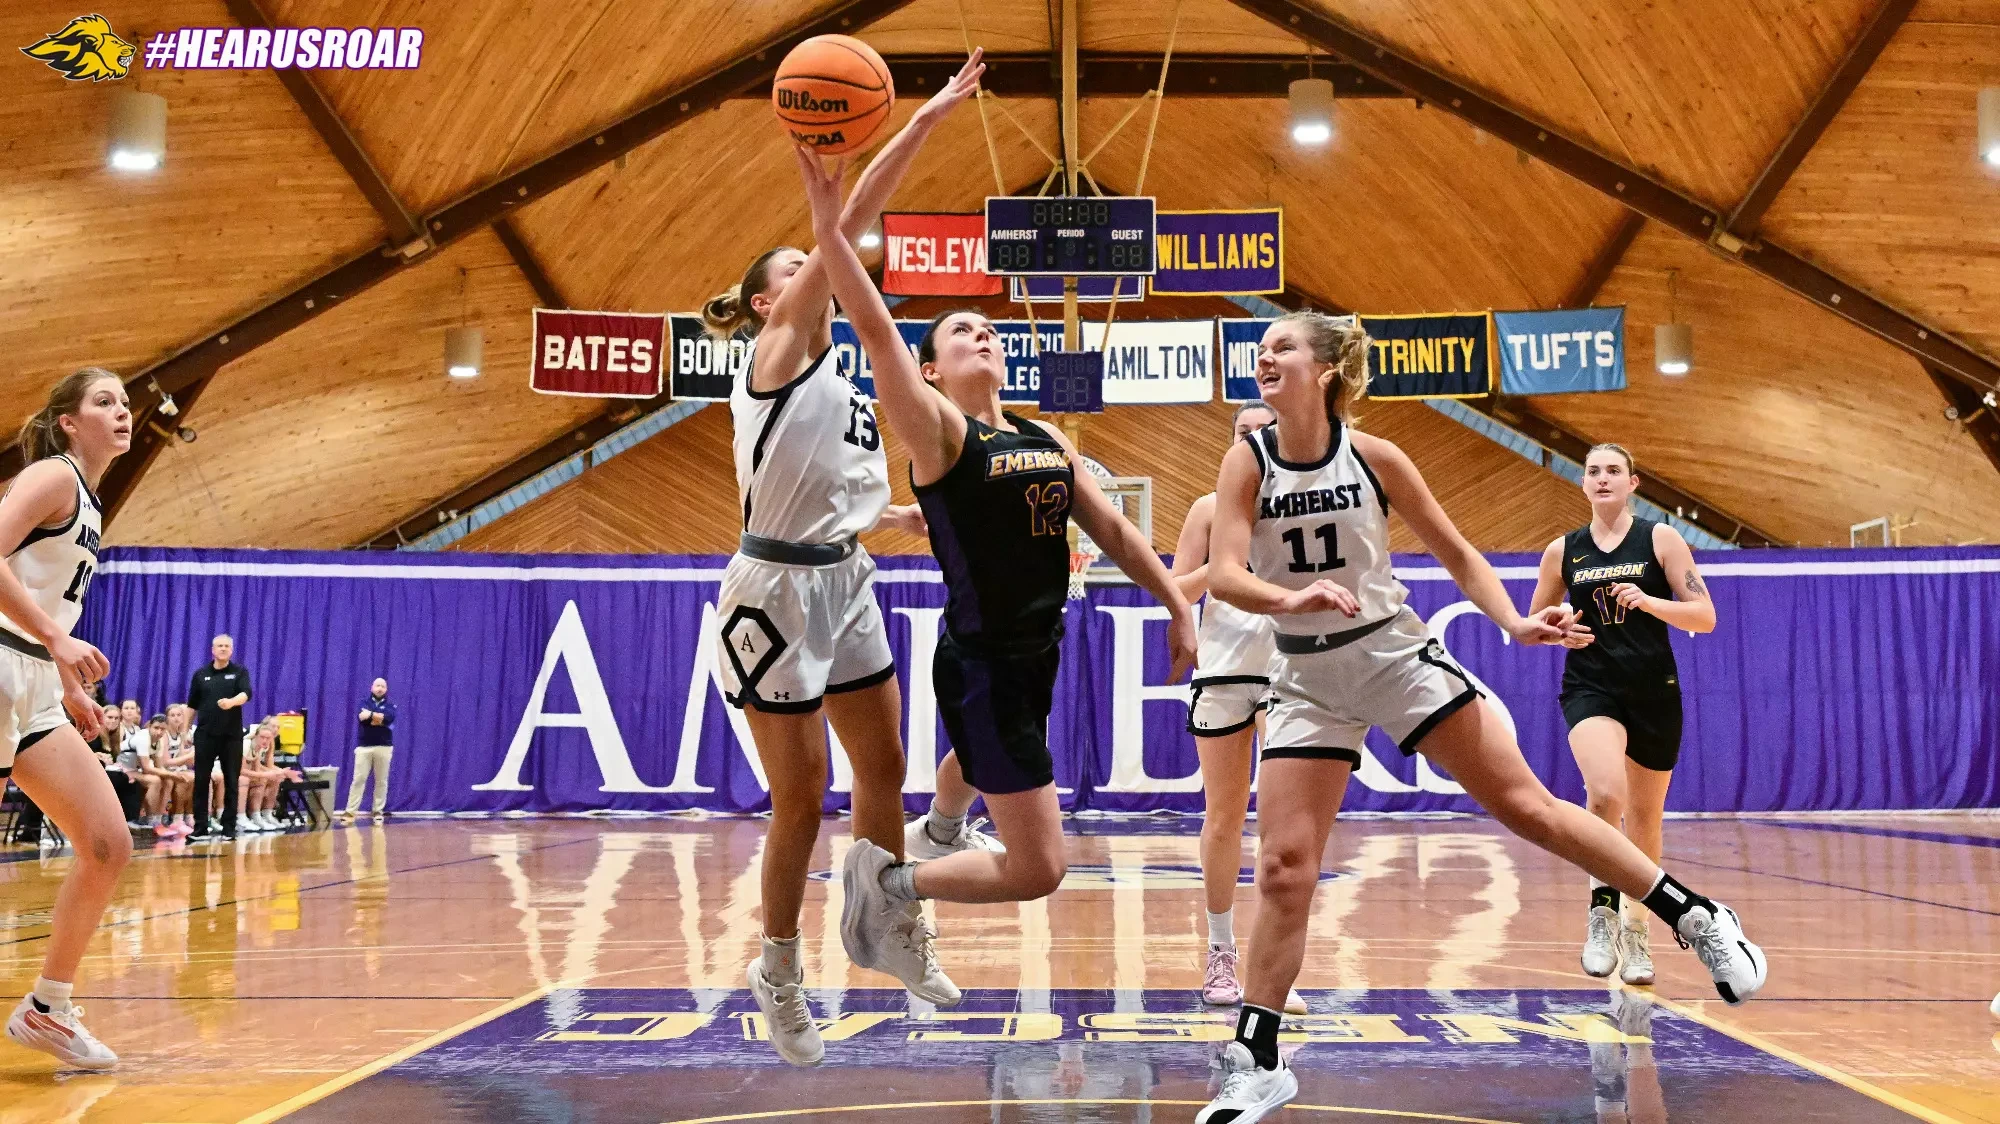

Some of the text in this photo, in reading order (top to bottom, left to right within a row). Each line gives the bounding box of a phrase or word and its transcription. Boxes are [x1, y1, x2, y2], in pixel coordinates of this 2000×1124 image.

[778, 88, 849, 113] Wilson
[991, 229, 1038, 241] AMHERST
[1057, 229, 1085, 238] PERIOD
[1111, 229, 1144, 241] GUEST
[1156, 232, 1275, 270] WILLIAMS
[887, 235, 986, 273] WESLEYA
[543, 334, 653, 374] BATES
[679, 338, 748, 376] BOWD
[1091, 345, 1205, 380] AMILTON
[1374, 337, 1475, 375] TRINITY
[1507, 330, 1615, 371] TUFTS
[843, 396, 880, 452] 13
[1025, 481, 1069, 537] 12
[1260, 482, 1362, 520] AMHERST
[1281, 523, 1346, 573] 11
[1573, 562, 1646, 584] EMERSON
[740, 632, 756, 654] A
